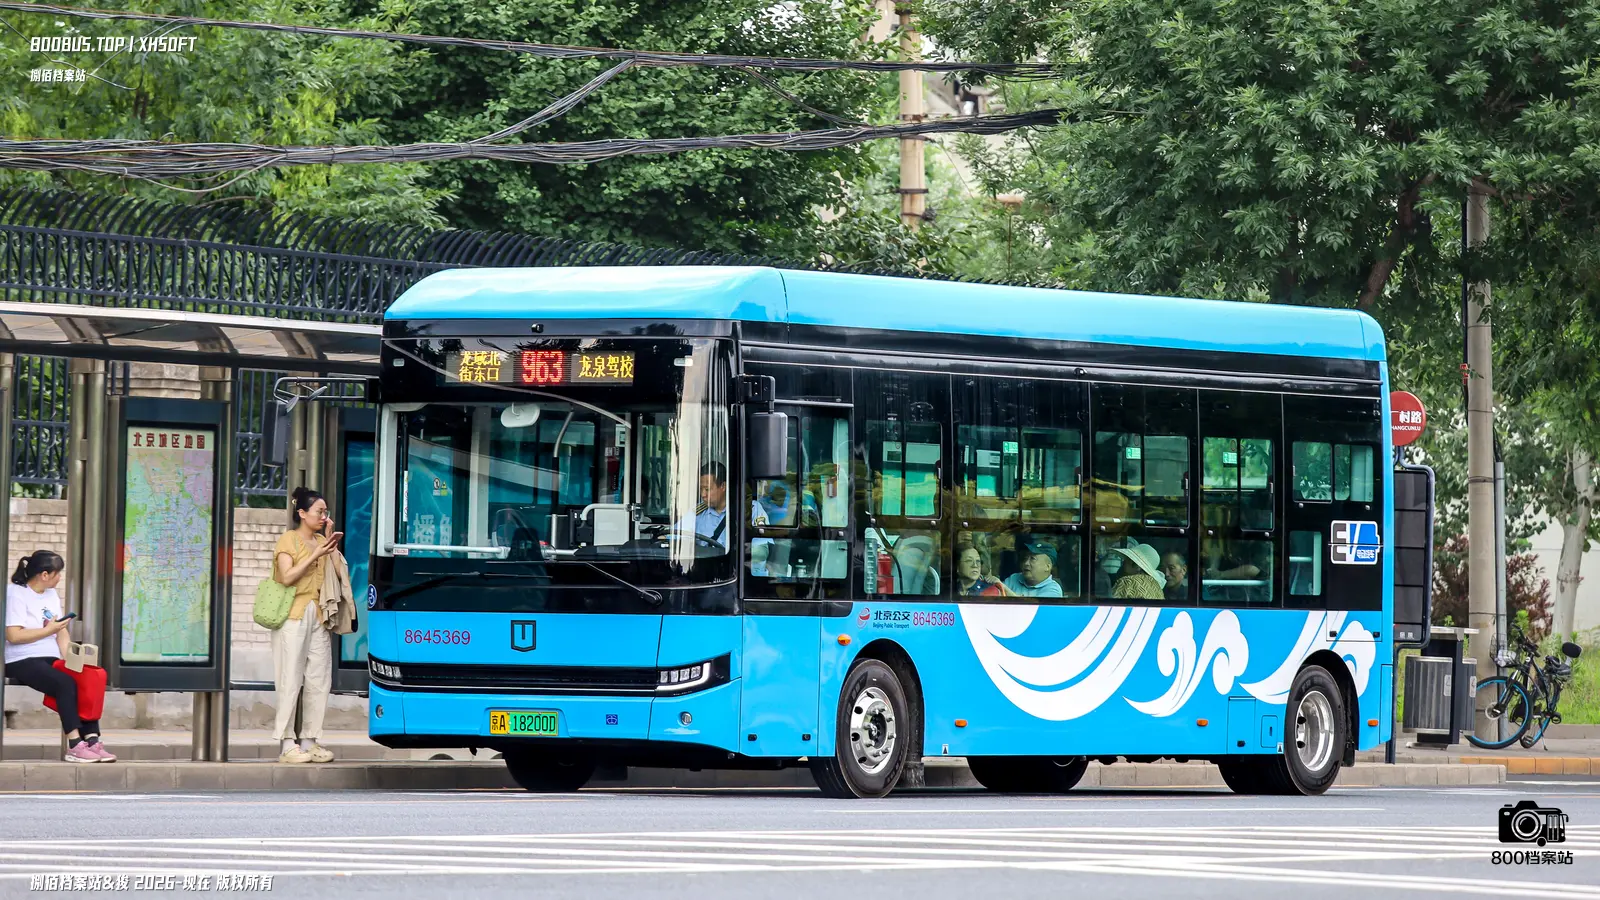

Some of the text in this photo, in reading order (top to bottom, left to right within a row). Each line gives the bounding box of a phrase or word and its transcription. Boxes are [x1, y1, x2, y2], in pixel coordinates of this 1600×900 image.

[460, 351, 501, 366] 龙域北
[578, 355, 634, 378] 龙泉驾校
[459, 366, 499, 382] 街东口
[522, 351, 563, 383] 963
[133, 432, 205, 449] 北京城区地图
[873, 610, 955, 626] 北京公交 8645369
[404, 630, 471, 645] 8645369
